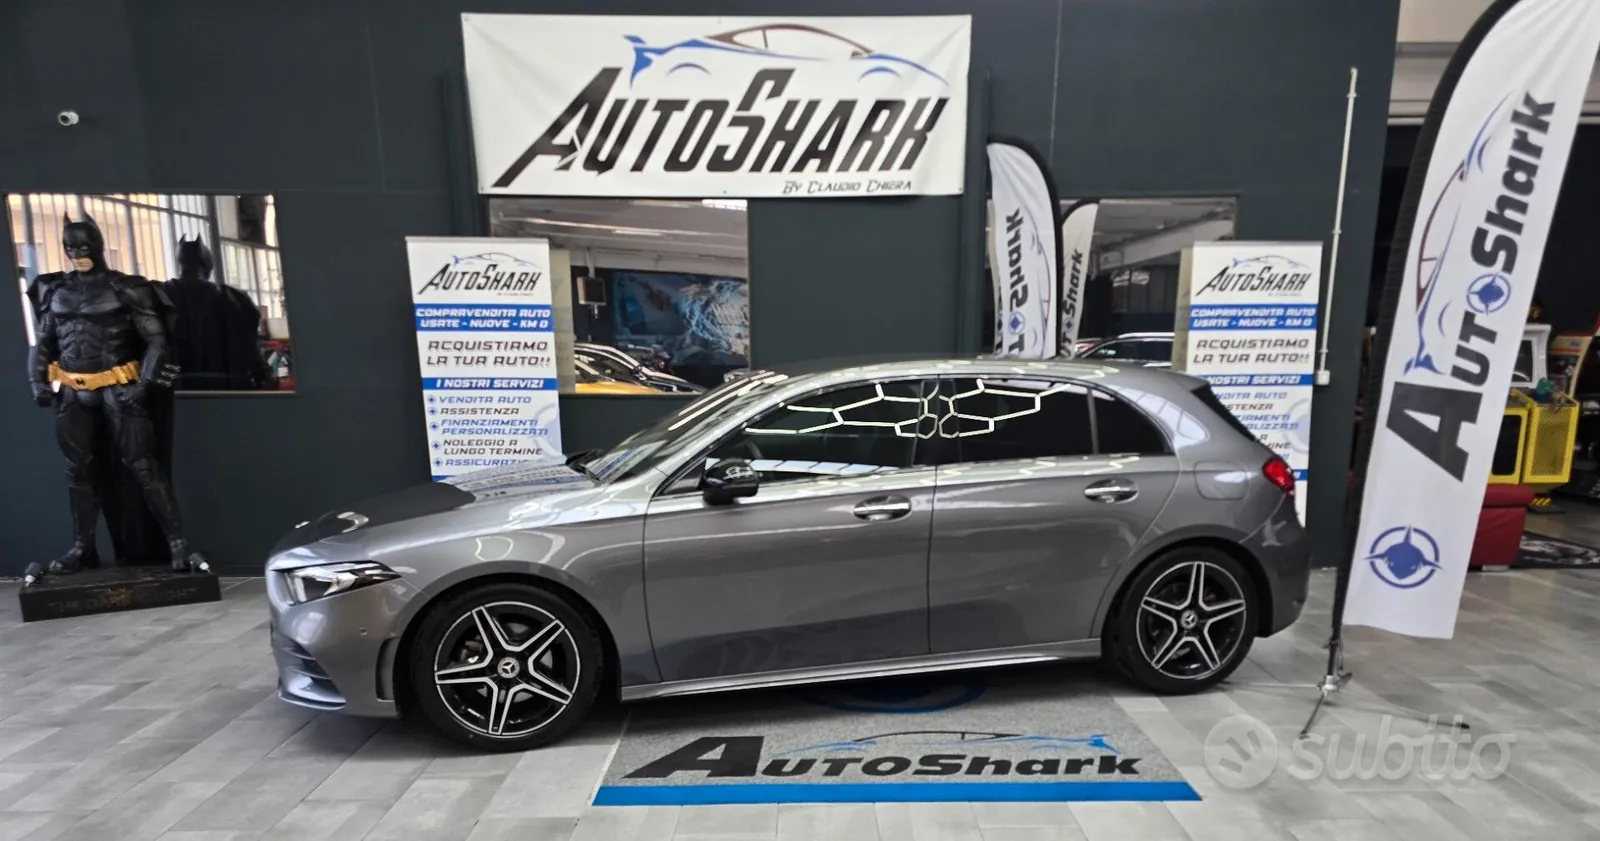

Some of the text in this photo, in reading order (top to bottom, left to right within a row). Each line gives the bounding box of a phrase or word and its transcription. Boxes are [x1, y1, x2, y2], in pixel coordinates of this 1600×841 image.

[416, 308, 551, 317] COMPRAVENDITA AUTO
[1191, 307, 1316, 317] COMPRAVENDITA AUTO
[420, 319, 460, 328] USATE
[469, 319, 510, 328] NUOVE
[519, 320, 537, 328] KM
[1193, 319, 1229, 327] USATE
[1238, 318, 1277, 327] NUOVE
[1285, 318, 1301, 327] KM
[427, 340, 548, 351] ACQUISTIAMO
[1196, 338, 1309, 349] ACQUISTIAMO
[426, 356, 448, 366] LA
[453, 356, 487, 366] TUA
[1193, 353, 1213, 363] LA
[1219, 353, 1250, 363] TUA
[436, 379, 544, 388] I NOSTRI SERVIZI
[1252, 375, 1301, 384] SERVIZI
[1254, 391, 1287, 399] AUTO
[439, 396, 532, 404] VENDITA AUTO
[440, 407, 519, 415] ASSISTENZA
